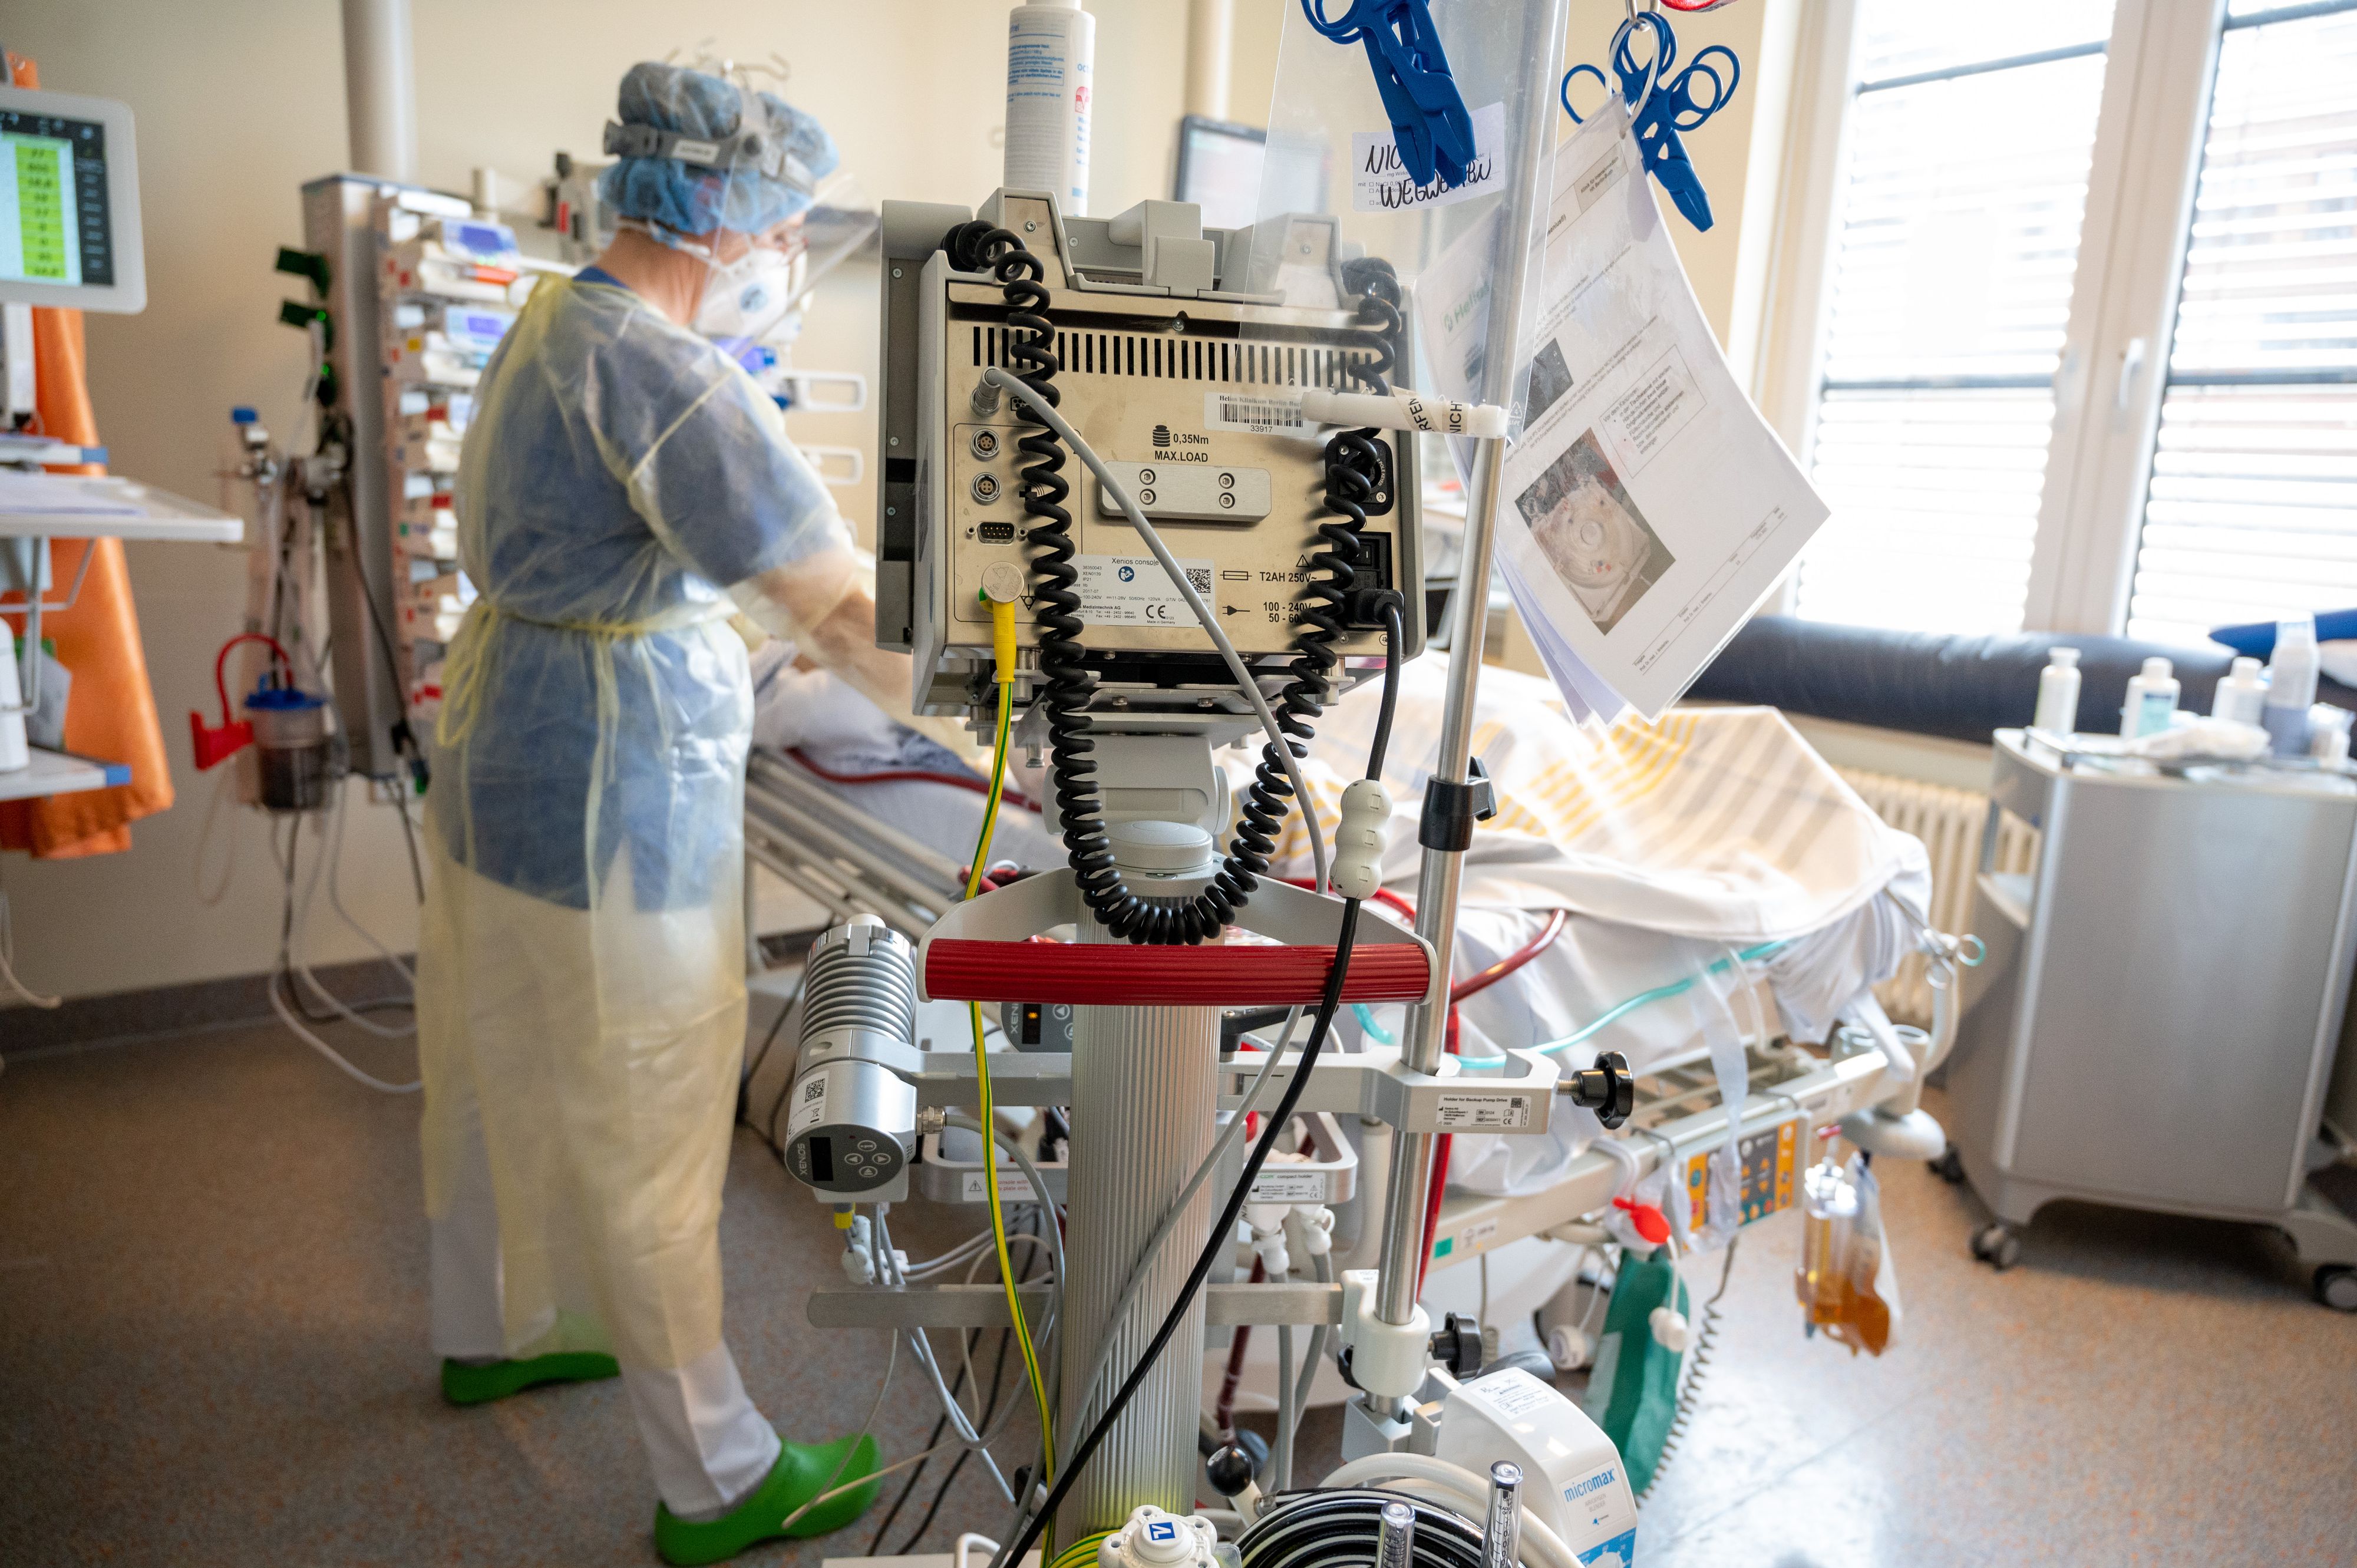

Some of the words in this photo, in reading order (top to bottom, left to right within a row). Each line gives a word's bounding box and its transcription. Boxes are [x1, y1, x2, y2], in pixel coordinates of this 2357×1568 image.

[1365, 144, 1404, 174] NIC
[1450, 401, 1463, 434] NICH
[1250, 425, 1273, 433] 33917
[1173, 433, 1209, 445] 0,35Nm
[1155, 450, 1209, 463] MAX.LOAD
[1259, 572, 1285, 582] T2AH
[1288, 572, 1317, 583] 250V~
[1263, 602, 1279, 611] 100
[1288, 602, 1312, 612] 240V
[1269, 613, 1279, 623] 50
[1288, 613, 1300, 623] 60
[797, 1143, 808, 1176] XENIOS
